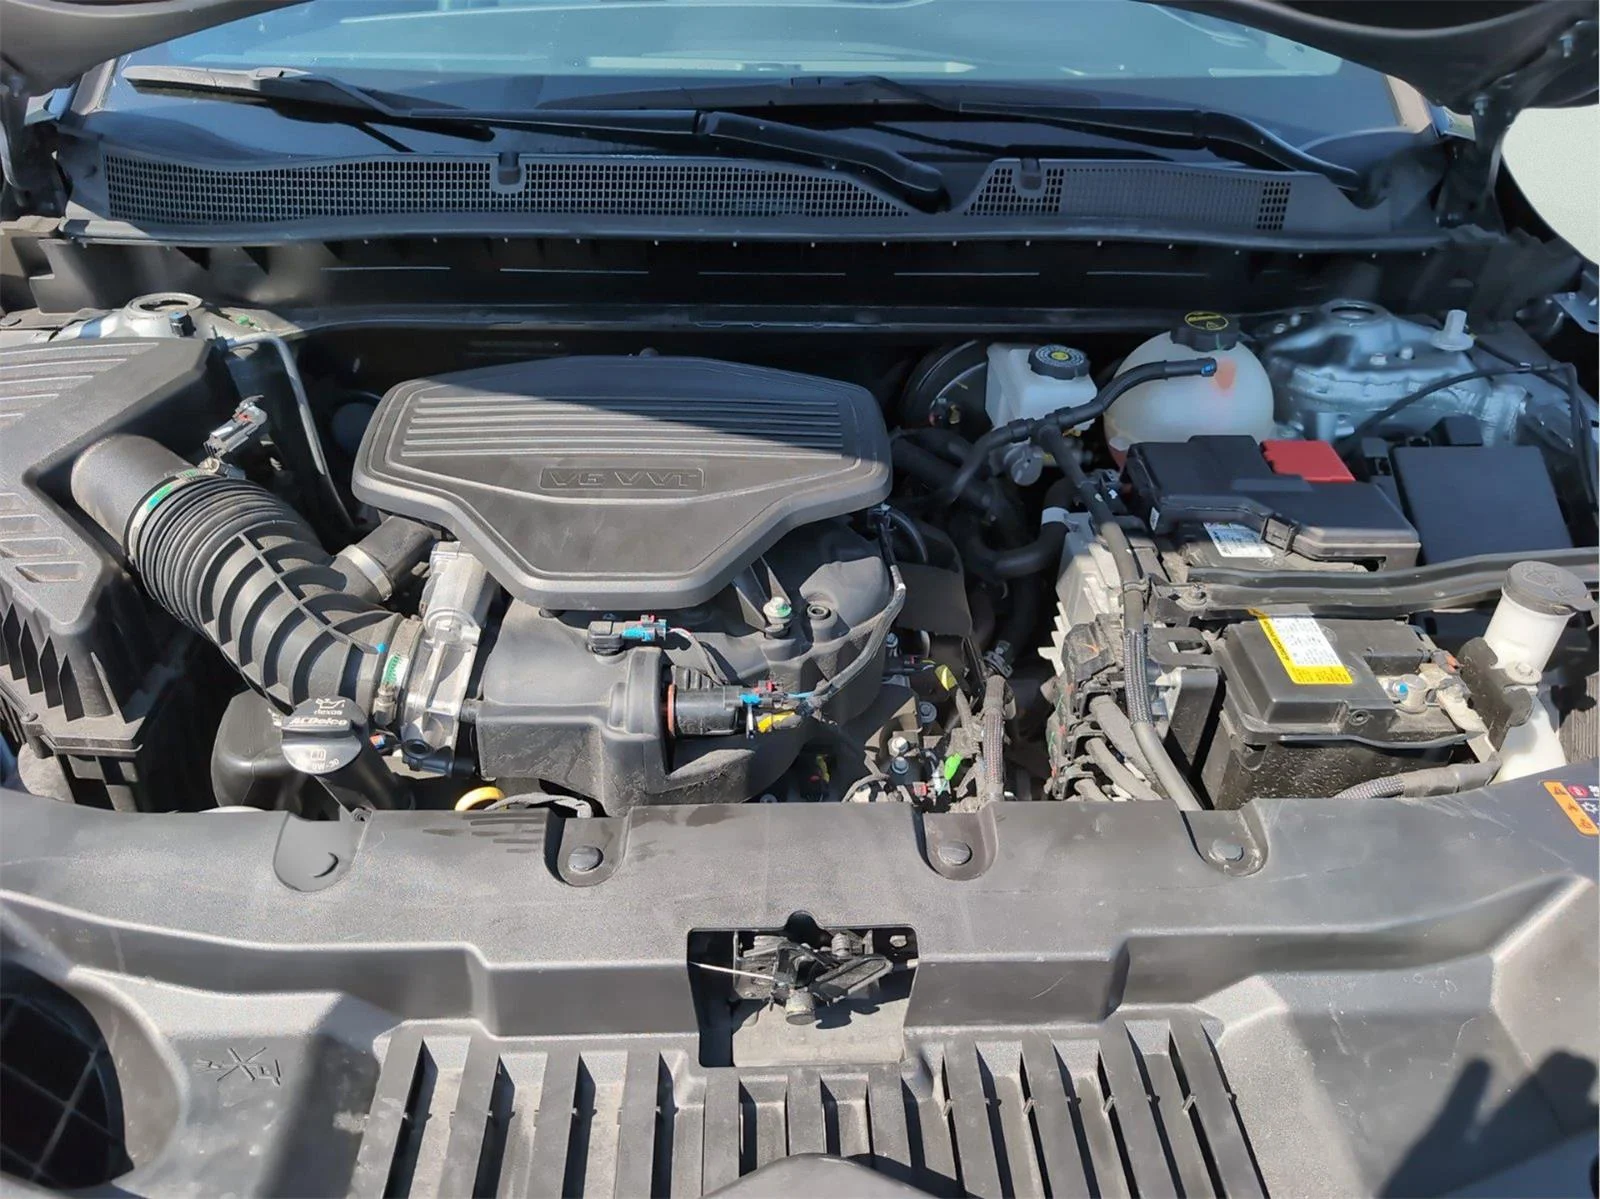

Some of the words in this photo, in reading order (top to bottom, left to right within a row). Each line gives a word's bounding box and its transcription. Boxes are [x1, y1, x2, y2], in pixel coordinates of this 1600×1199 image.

[549, 470, 607, 487] V6
[613, 470, 699, 487] VVT
[289, 717, 348, 725] ACDelco
